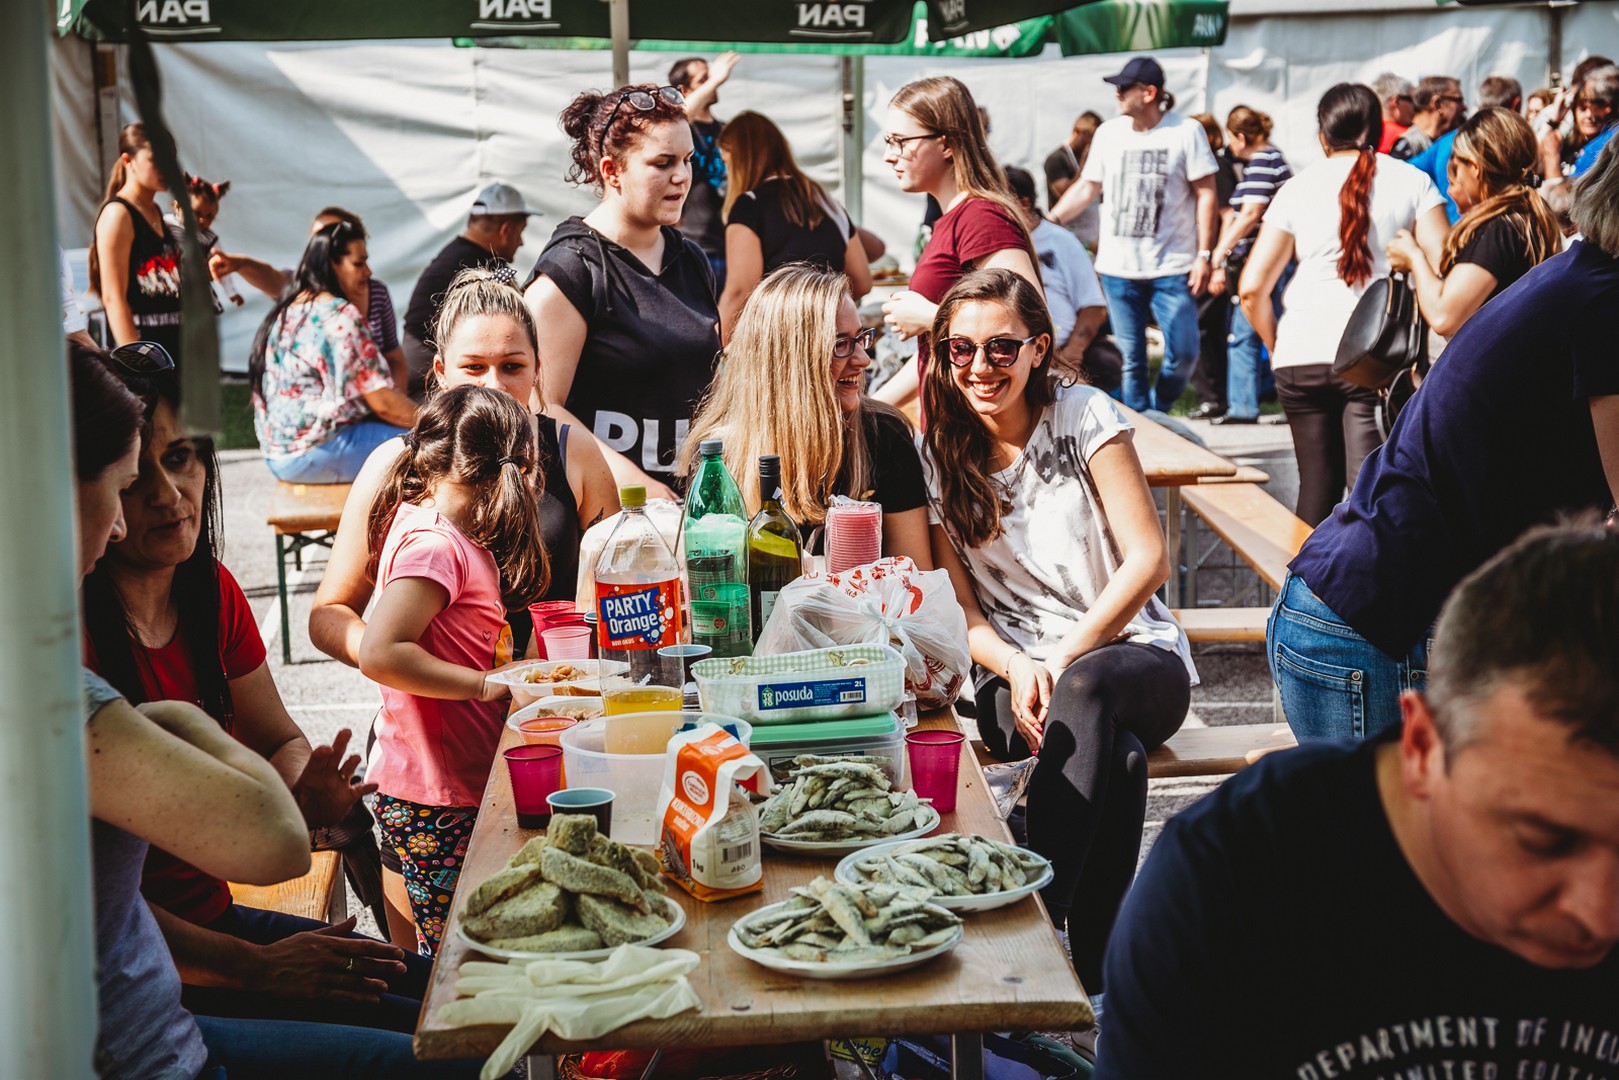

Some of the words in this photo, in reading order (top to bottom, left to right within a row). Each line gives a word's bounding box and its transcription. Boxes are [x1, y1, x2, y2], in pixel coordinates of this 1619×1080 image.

[605, 591, 651, 618] PARTY
[609, 612, 659, 635] Orange
[775, 686, 813, 705] posuda
[1297, 1015, 1498, 1080] DEPARTMENT
[1376, 1060, 1498, 1080] MITED
[1517, 1059, 1607, 1080] EDIT
